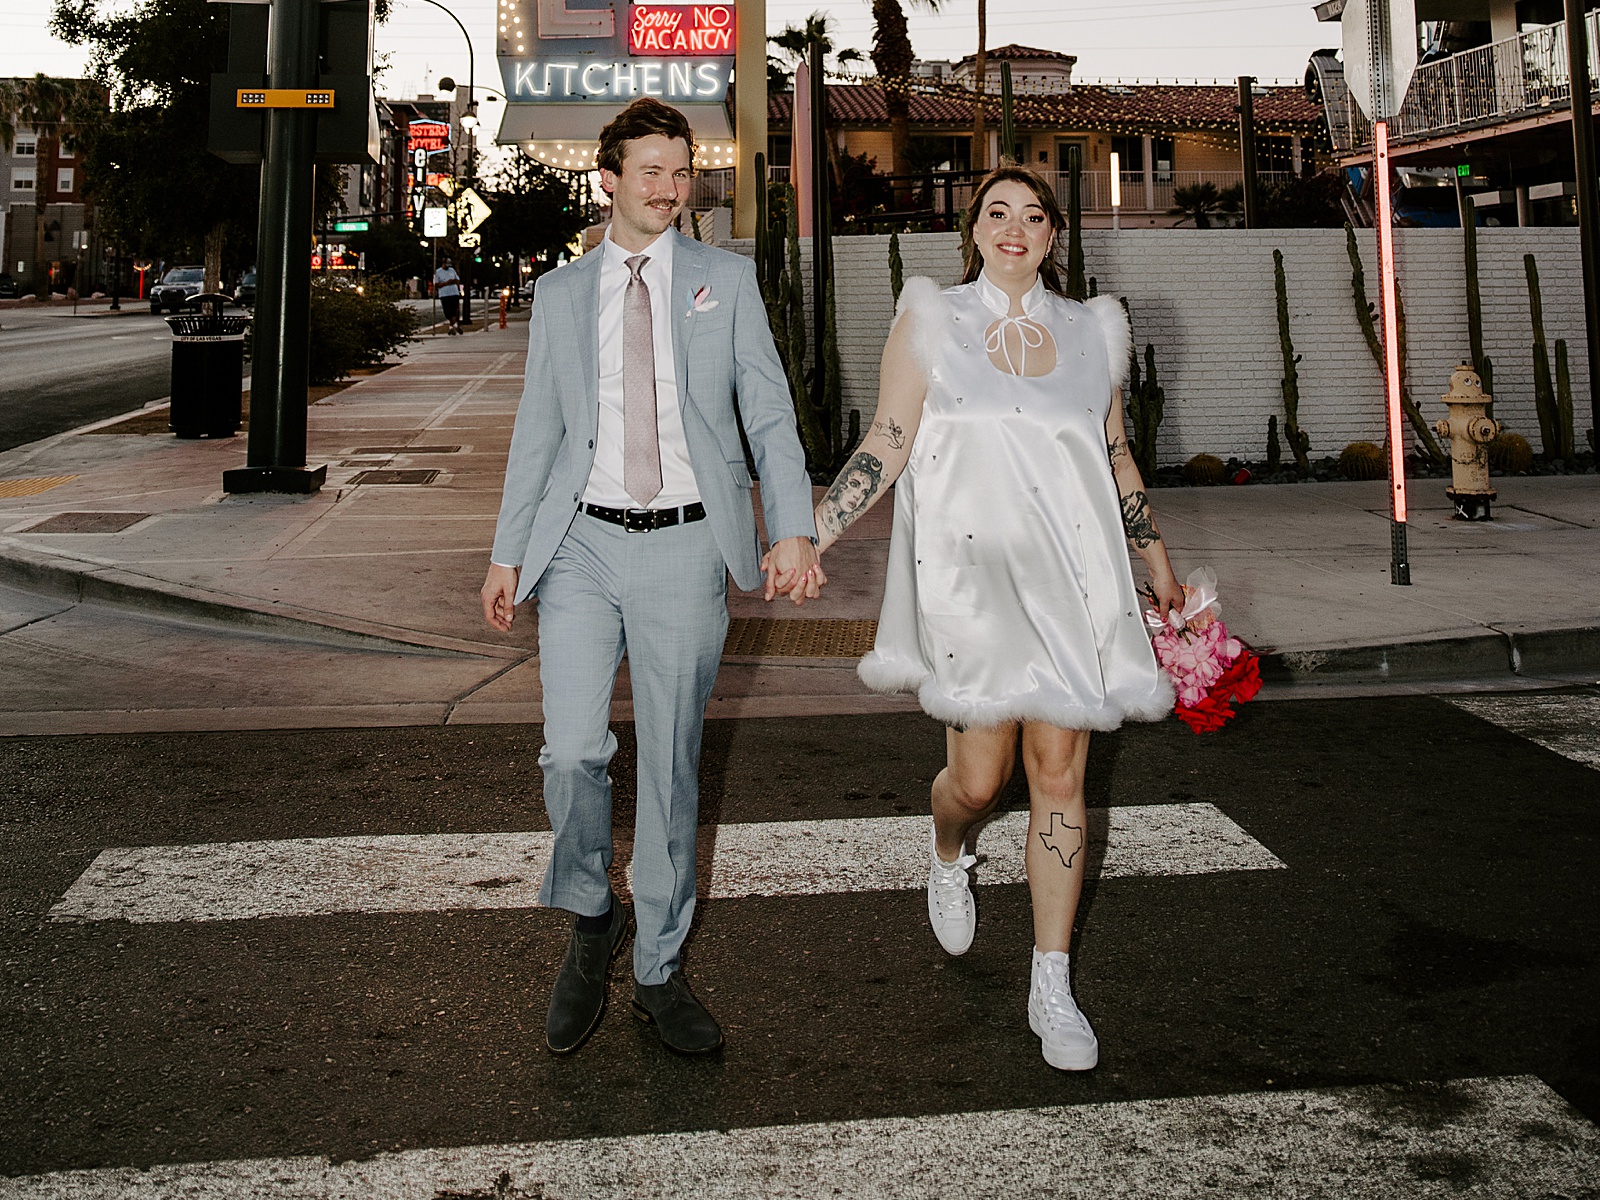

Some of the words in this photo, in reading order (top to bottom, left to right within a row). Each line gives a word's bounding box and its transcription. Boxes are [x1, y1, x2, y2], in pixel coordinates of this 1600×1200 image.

[633, 6, 683, 32] Sorry
[694, 6, 730, 28] NO
[631, 27, 732, 50] VACANCY
[515, 61, 721, 97] KITCHENS
[408, 124, 449, 136] ESTERN
[1458, 164, 1470, 177] EXIT
